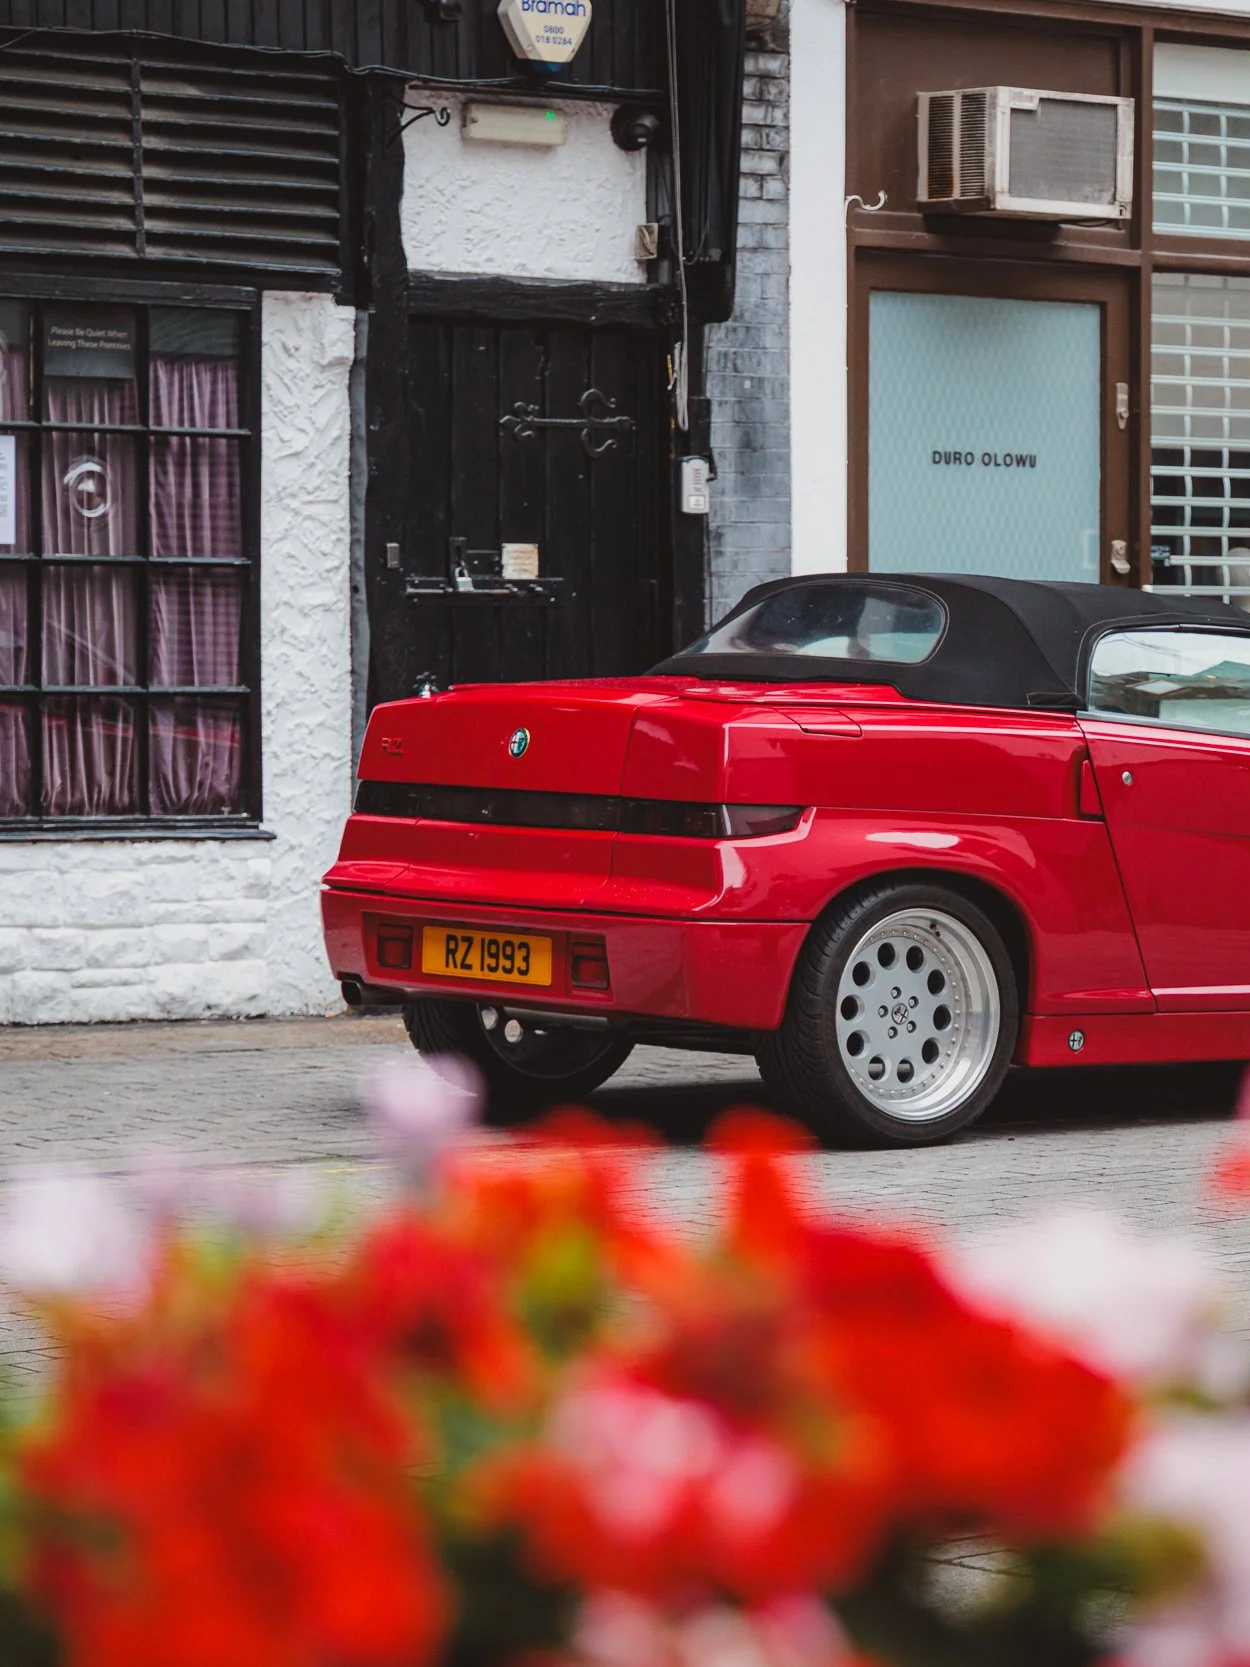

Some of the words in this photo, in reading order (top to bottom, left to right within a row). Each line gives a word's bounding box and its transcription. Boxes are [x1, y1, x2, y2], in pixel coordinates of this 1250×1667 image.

[521, 0, 586, 17] Bramah
[51, 326, 75, 336] Please
[85, 328, 105, 338] Quiet
[107, 329, 128, 338] When
[48, 338, 76, 349] Leaving
[78, 339, 98, 348] These
[99, 340, 131, 350] Premises
[932, 450, 975, 466] DURO
[981, 452, 1037, 468] OLOWU
[445, 934, 474, 970] RZ
[480, 938, 530, 976] 1993
